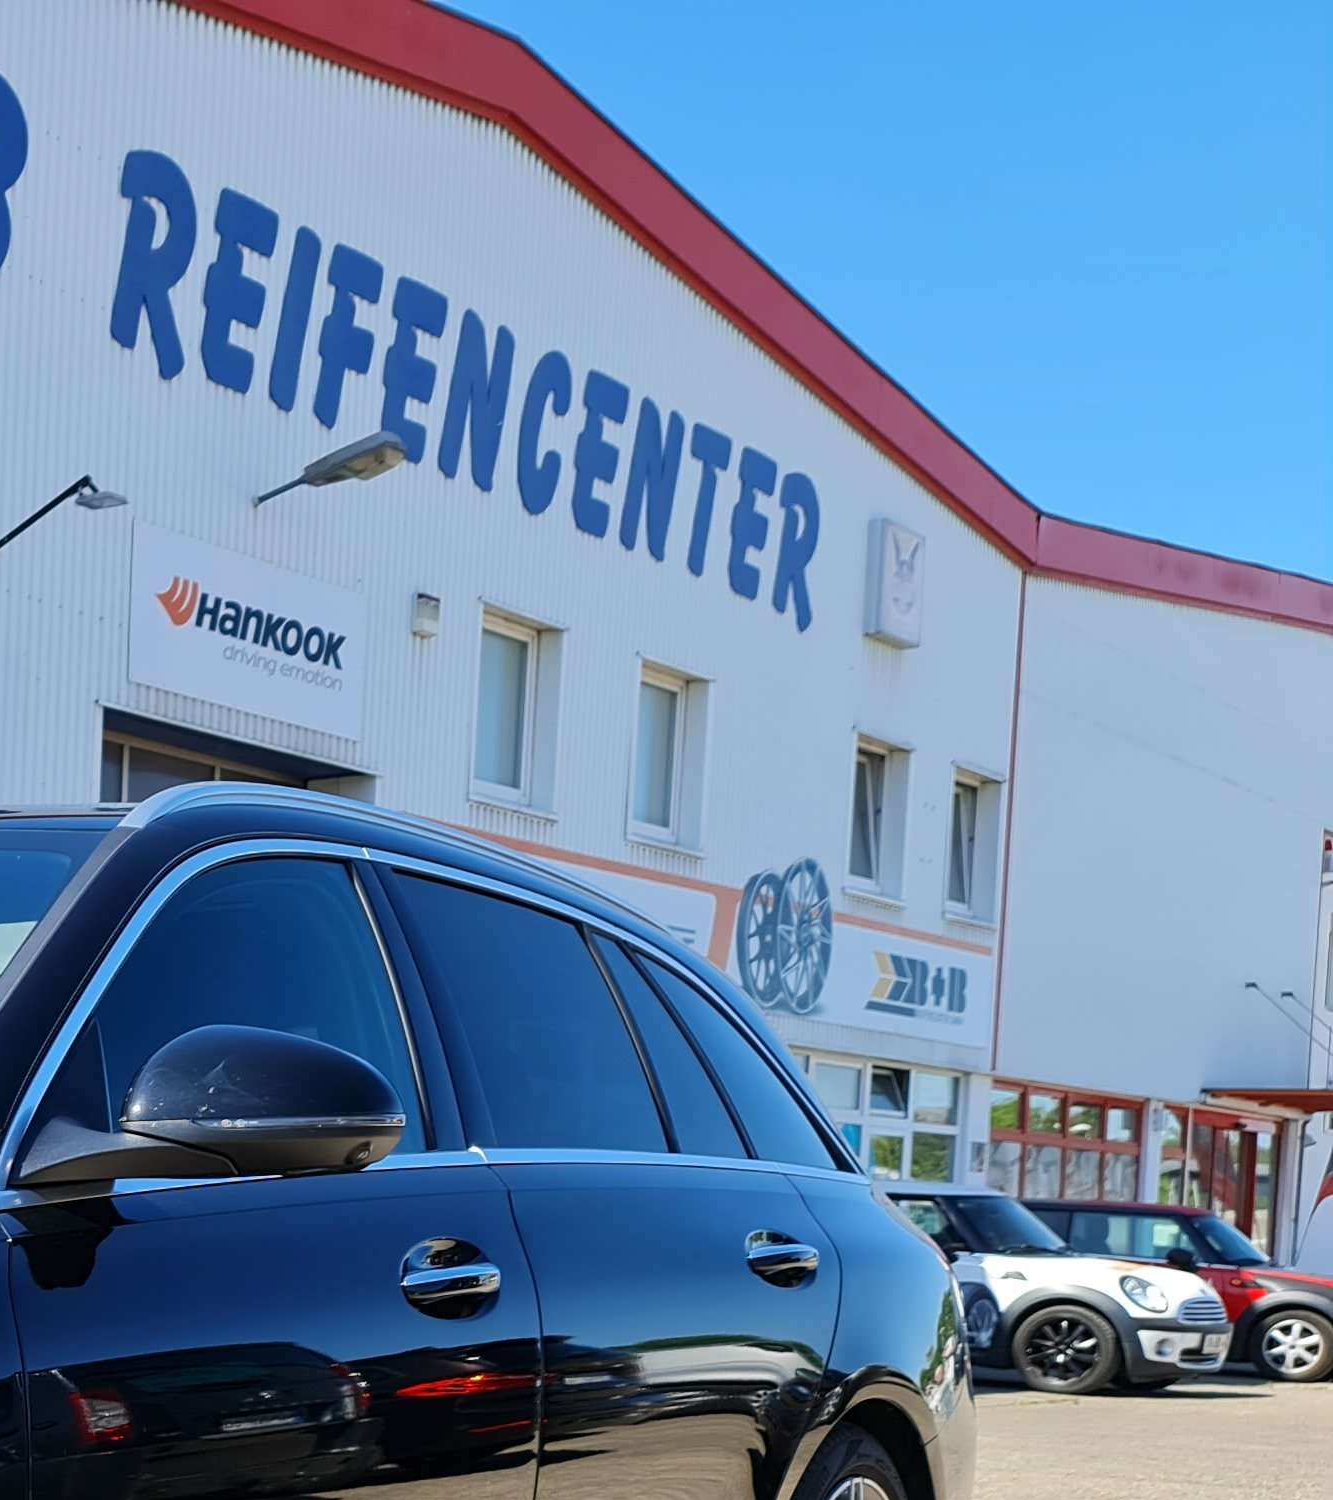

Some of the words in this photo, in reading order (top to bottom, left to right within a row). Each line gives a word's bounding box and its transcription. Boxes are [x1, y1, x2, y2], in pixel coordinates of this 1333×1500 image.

[111, 149, 820, 632] REIFENCENTER
[223, 644, 278, 676] driving
[279, 661, 343, 692] emotion
